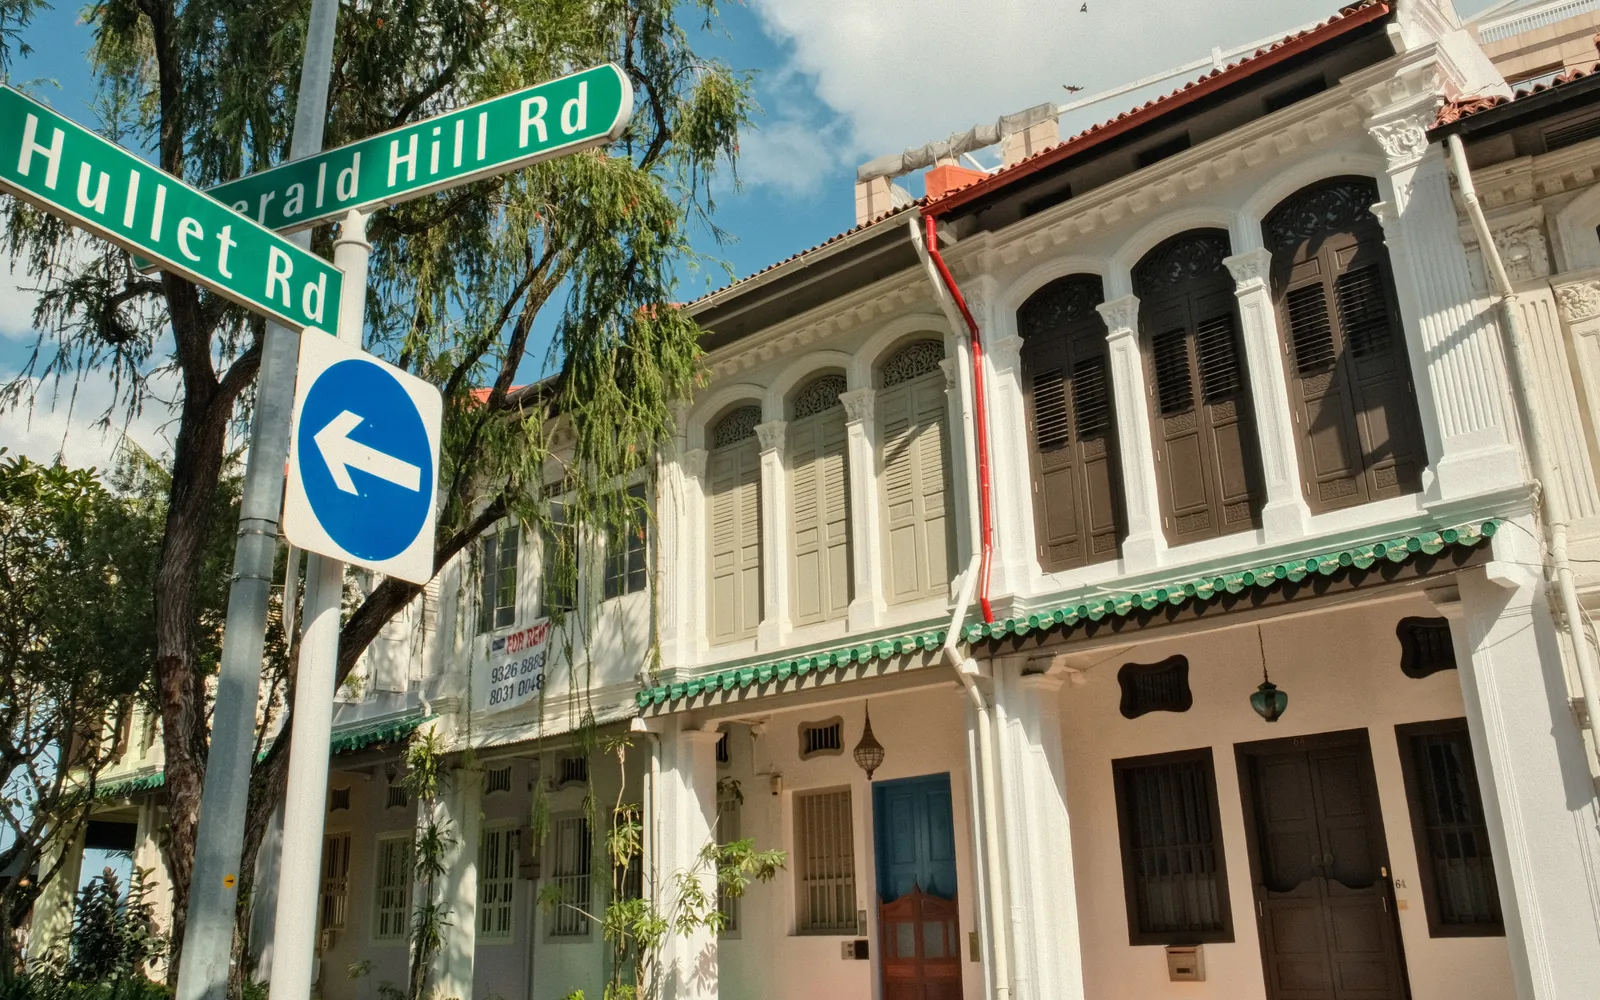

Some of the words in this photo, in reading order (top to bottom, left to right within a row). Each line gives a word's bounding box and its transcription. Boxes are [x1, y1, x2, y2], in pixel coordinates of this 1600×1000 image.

[387, 112, 488, 188] Hill
[519, 81, 588, 149] Rd
[17, 112, 238, 279] Hullet
[265, 245, 327, 324] Rd
[506, 631, 525, 655] FOR
[491, 661, 518, 684] 9326
[489, 682, 514, 706] 8031
[518, 673, 546, 697] 0048
